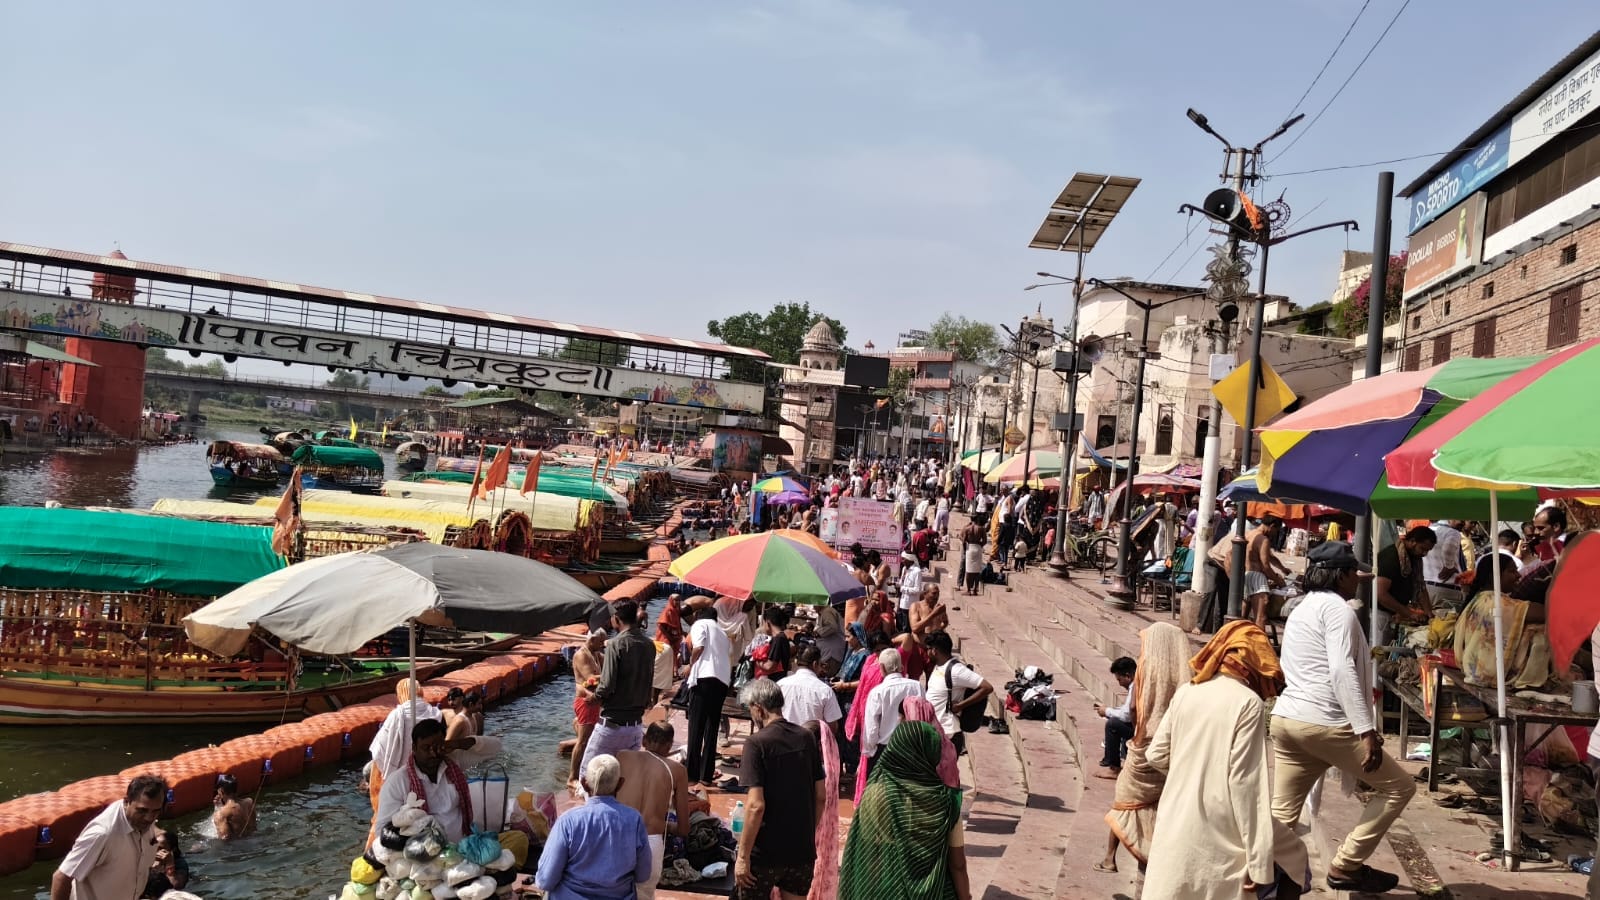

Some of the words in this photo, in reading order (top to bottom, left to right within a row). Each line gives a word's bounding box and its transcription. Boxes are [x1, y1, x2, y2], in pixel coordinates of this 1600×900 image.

[1568, 90, 1592, 117] चित्रकूट
[1427, 177, 1459, 210] SPORTO
[1411, 241, 1434, 266] DOLLAR
